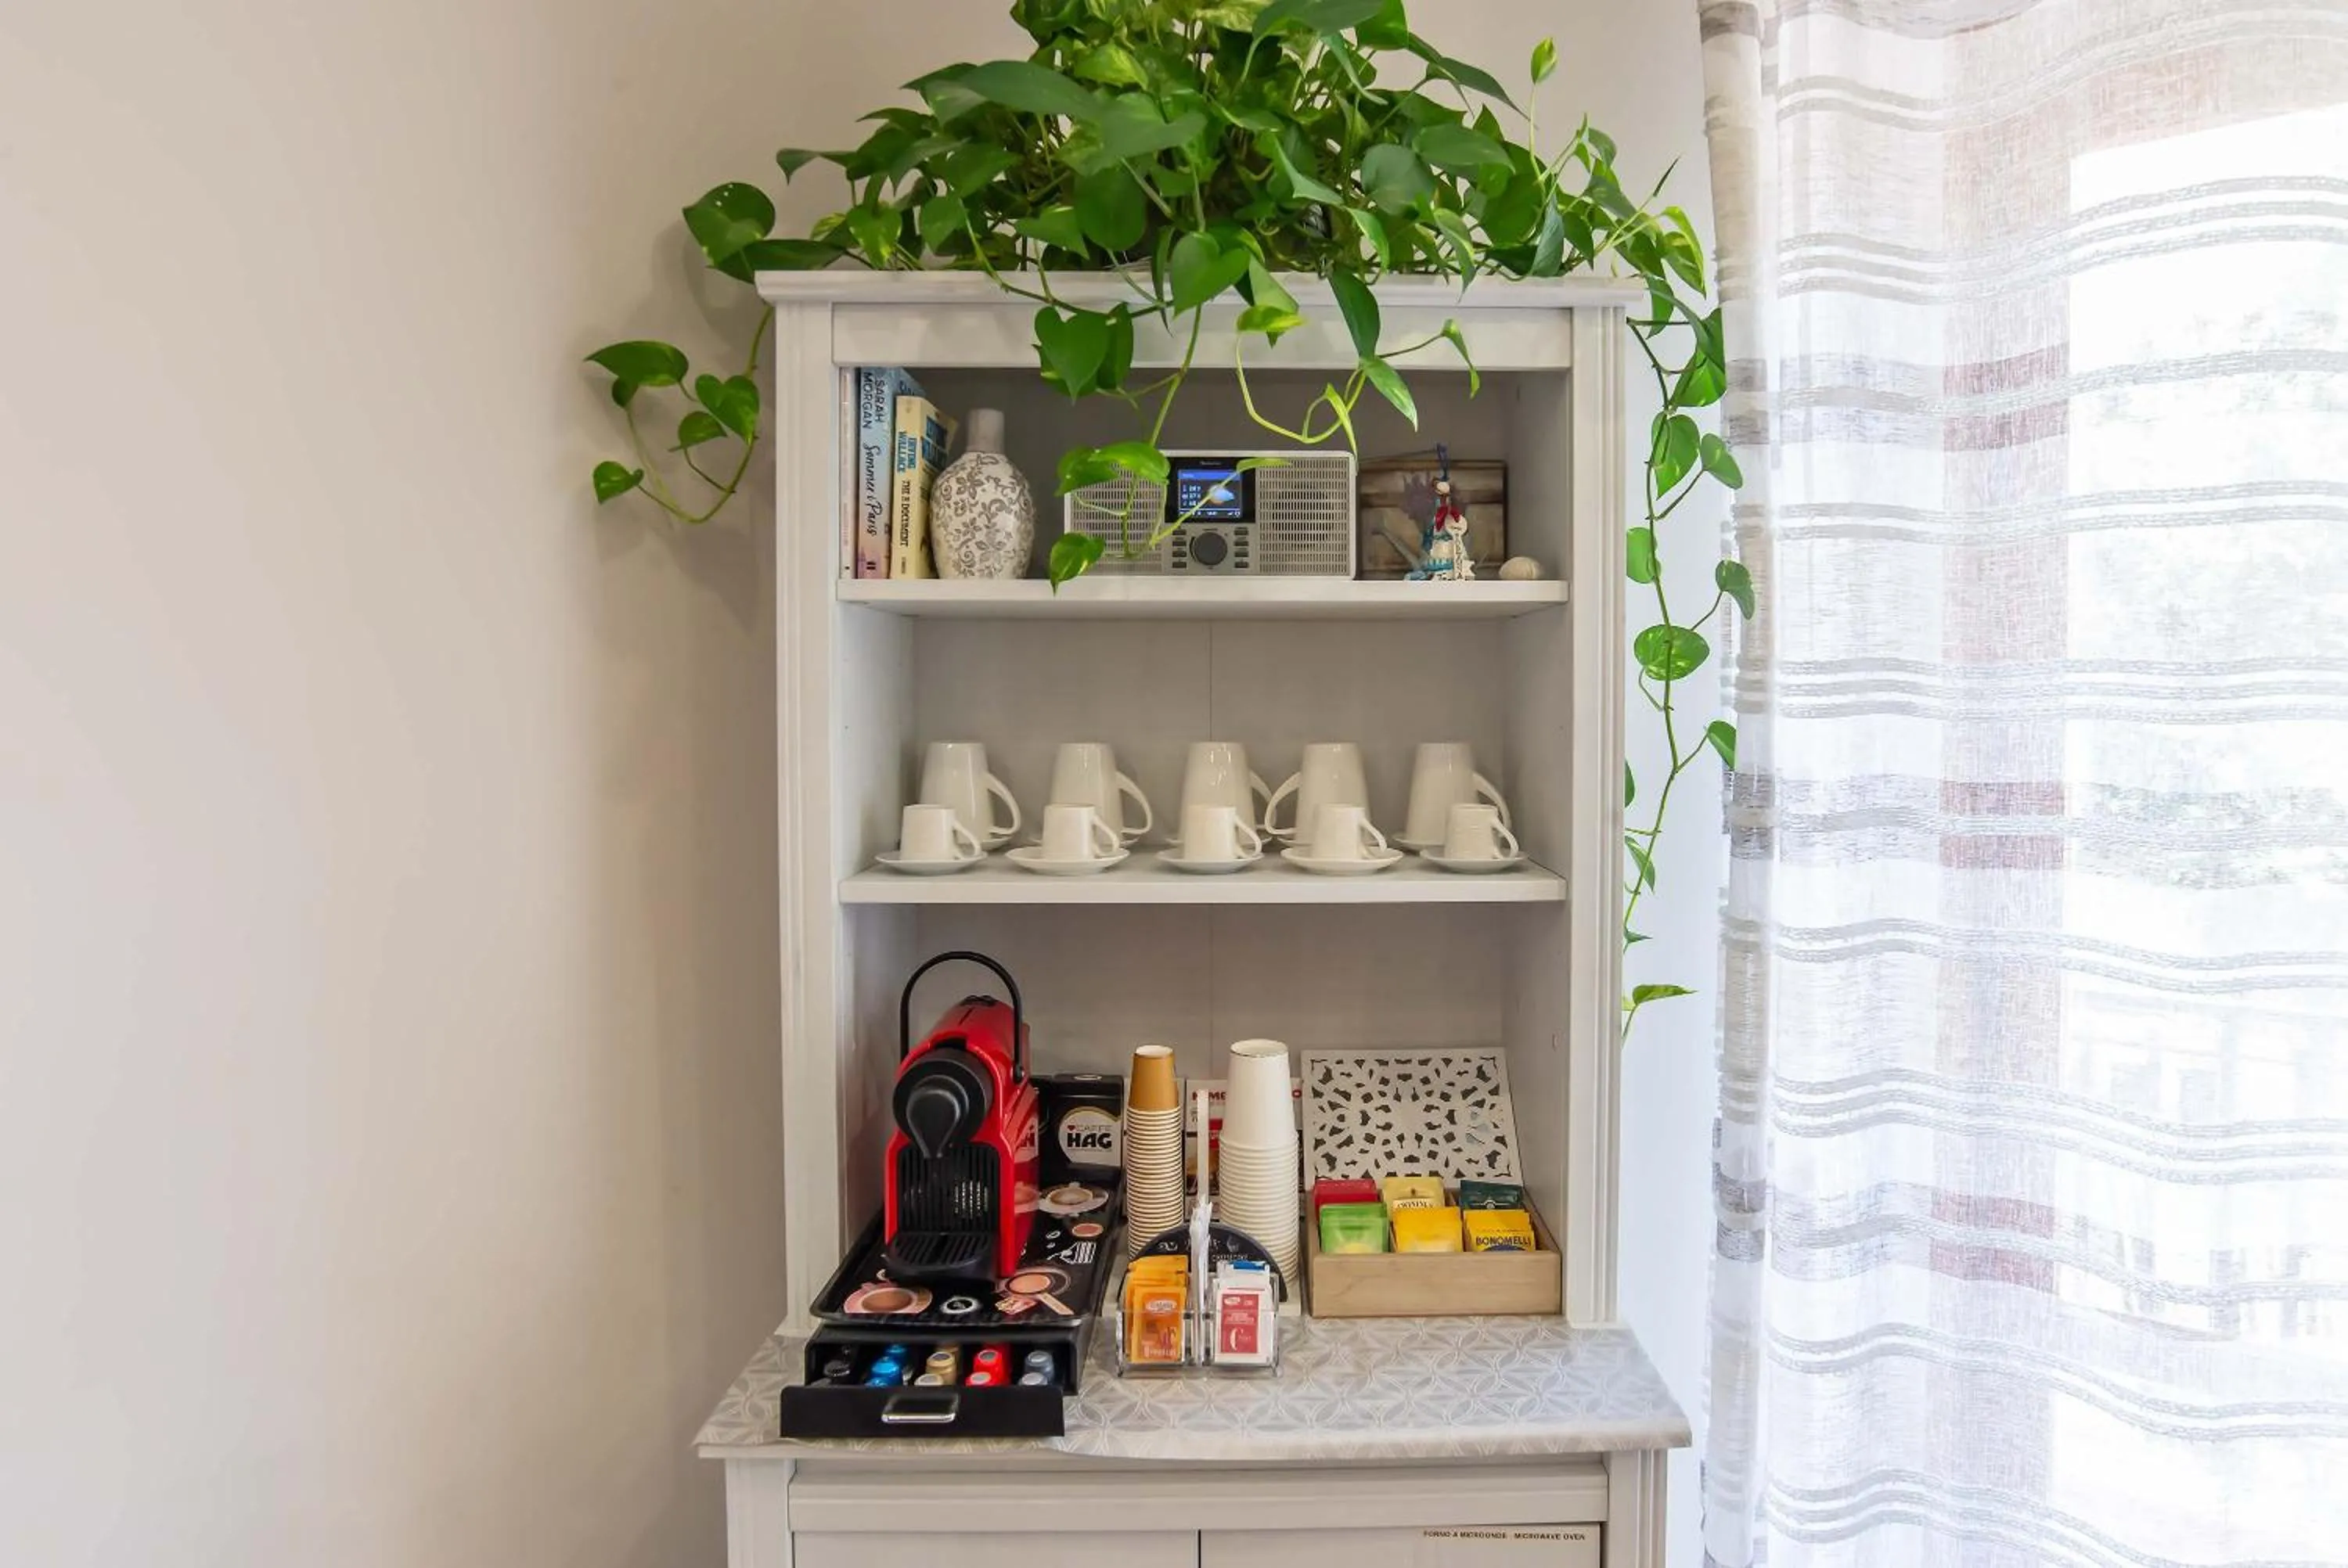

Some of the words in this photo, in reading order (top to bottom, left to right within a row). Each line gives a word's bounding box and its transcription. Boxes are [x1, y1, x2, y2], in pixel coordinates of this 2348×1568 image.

[862, 372, 873, 429] MORGAN
[875, 380, 884, 423] SARAH
[862, 441, 881, 491] Sommer
[902, 480, 910, 494] THE
[865, 501, 884, 537] Paris
[900, 503, 909, 547] DOCUMENT
[1068, 1132, 1112, 1149] HAG
[1476, 1235, 1532, 1246] BONOMELLI
